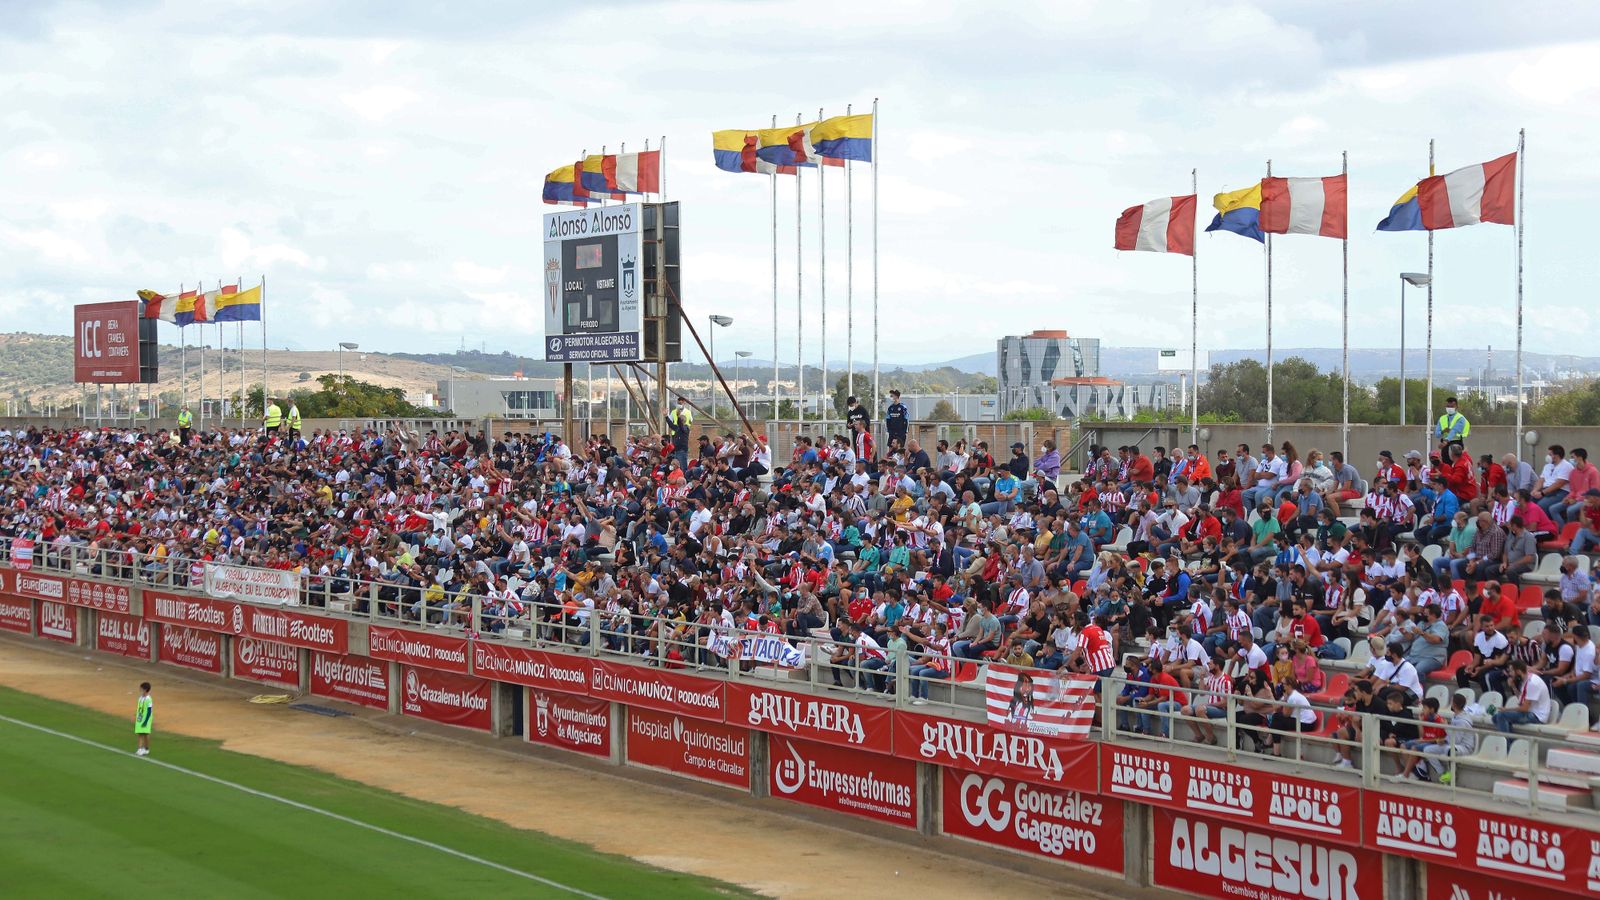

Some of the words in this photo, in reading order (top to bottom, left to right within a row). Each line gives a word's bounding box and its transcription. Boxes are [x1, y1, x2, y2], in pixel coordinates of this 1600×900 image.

[549, 217, 588, 238] Alonso
[591, 211, 632, 233] Alonso
[565, 281, 583, 291] LOCAL
[580, 320, 599, 329] PERIODO
[81, 320, 102, 358] ICC
[564, 337, 594, 347] PERMOTOR
[594, 336, 625, 346] ALGECIRAS
[625, 335, 636, 344] S.L.
[568, 350, 590, 359] SERVICIO
[590, 350, 609, 358] OFICIAL
[255, 587, 262, 596] EL
[194, 603, 225, 626] Footters
[163, 623, 183, 654] Pepe
[183, 628, 217, 657] Valencia
[298, 620, 334, 645] Footters
[256, 640, 297, 661] HYUNDAI
[434, 645, 465, 663] PODOLOGÍA
[741, 638, 752, 656] EL
[255, 656, 297, 672] PERMOTOR
[314, 654, 373, 687] Algetransit
[549, 667, 585, 684] PODOLOGÍA
[419, 684, 460, 707] Grazalema
[461, 691, 488, 711] Motor
[678, 690, 720, 709] PODOLOGÍA
[552, 702, 607, 729] Ayuntamiento
[631, 714, 672, 741] Hospital
[557, 725, 566, 737] de
[566, 727, 602, 746] Algeciras
[683, 751, 706, 769] Campo
[707, 758, 716, 769] de
[716, 758, 745, 777] Gibraltar
[1113, 752, 1170, 773] UNIVERSO
[808, 760, 911, 808] Expressreformas
[1111, 764, 1173, 793] APOLO
[1189, 766, 1251, 787] UNIVERSO
[1014, 783, 1104, 826] González
[1187, 778, 1254, 809] APOLO
[1272, 781, 1339, 805] UNIVERSO
[1269, 792, 1342, 827] APOLO
[1379, 799, 1453, 825] UNIVERSO
[1014, 811, 1097, 855] Gaggero
[1377, 813, 1457, 849] APOLO
[1479, 818, 1561, 847] UNIVERSO
[1169, 817, 1360, 900] ALGESUR
[1476, 833, 1566, 871] APOLO
[1222, 881, 1258, 899] Recambios
